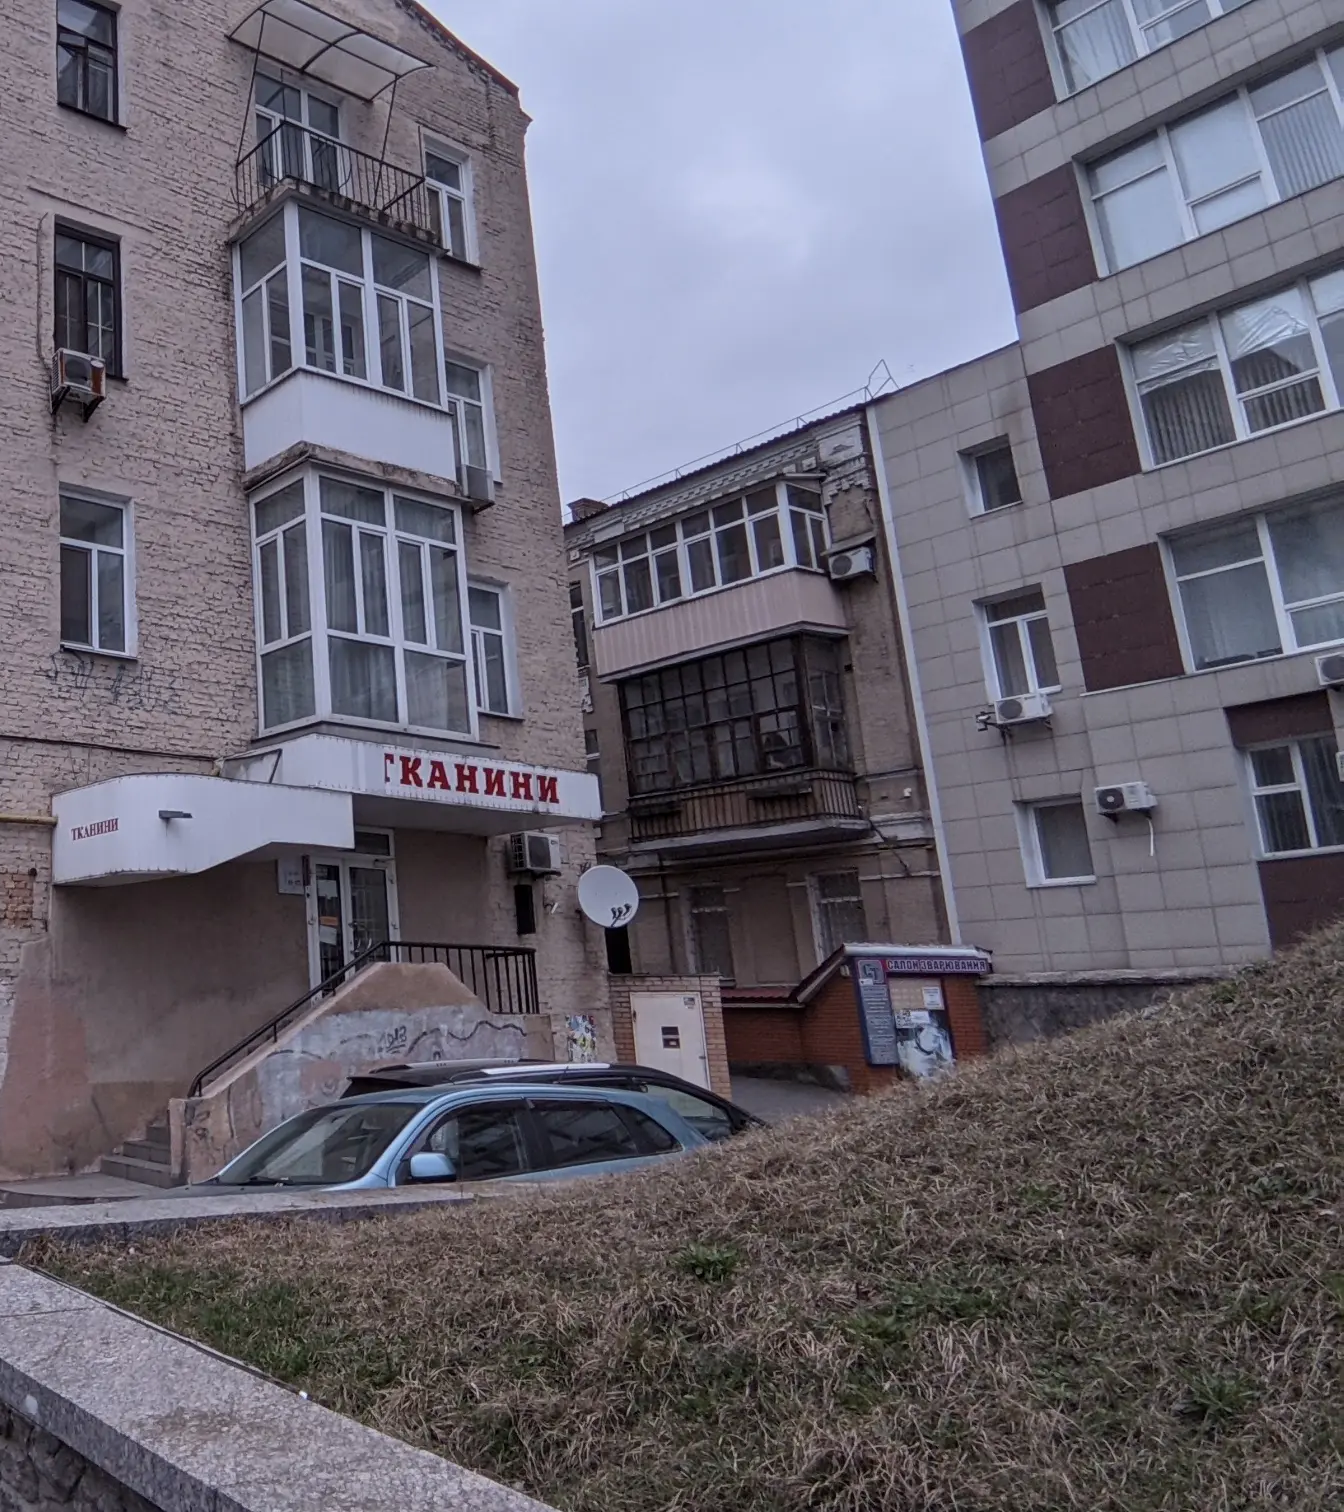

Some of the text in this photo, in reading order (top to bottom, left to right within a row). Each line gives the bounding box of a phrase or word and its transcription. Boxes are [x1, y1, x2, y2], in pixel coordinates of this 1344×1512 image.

[70, 817, 119, 841] ТКАНИНИ
[887, 959, 987, 972] САЛОН ЗВАРЮВАННЯ
